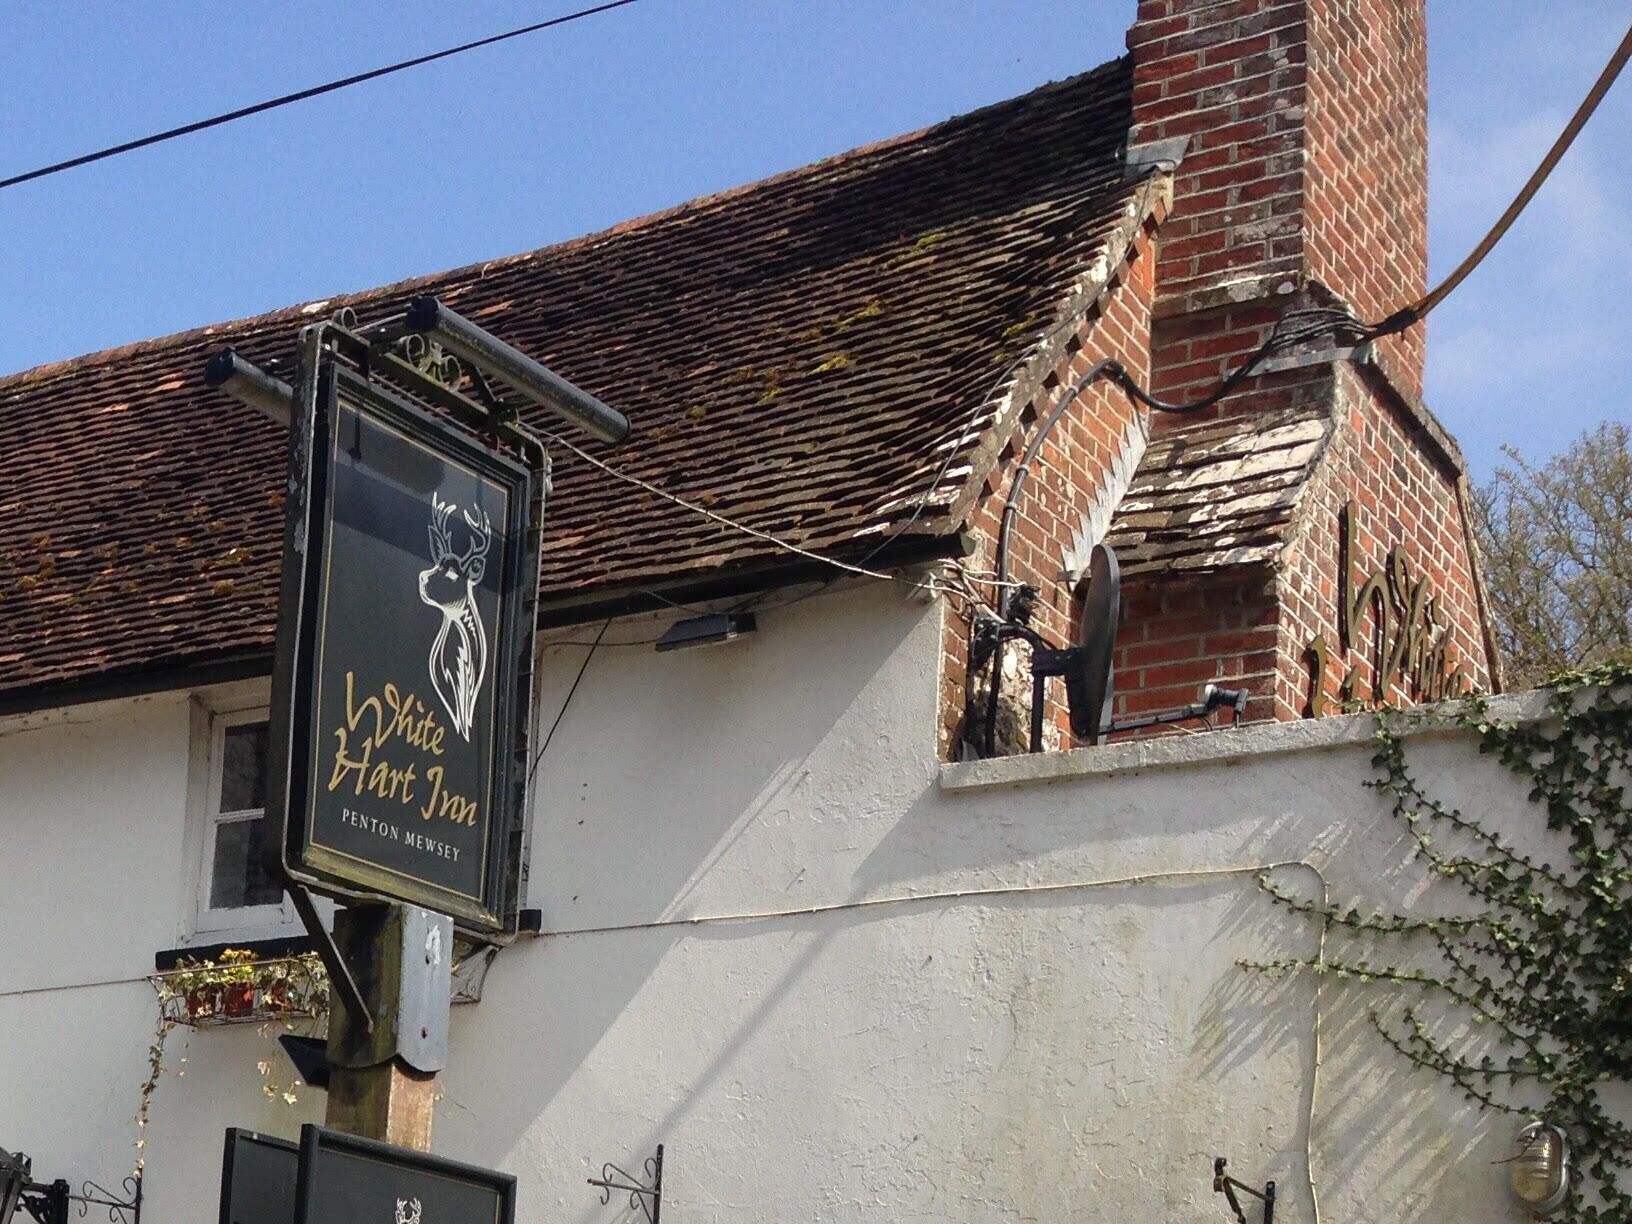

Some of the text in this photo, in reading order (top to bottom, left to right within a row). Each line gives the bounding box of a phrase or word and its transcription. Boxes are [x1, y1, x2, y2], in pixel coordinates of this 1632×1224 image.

[345, 671, 445, 756] White
[328, 727, 478, 827] Hart Inn
[342, 807, 461, 862] PENTON MEWSEY
